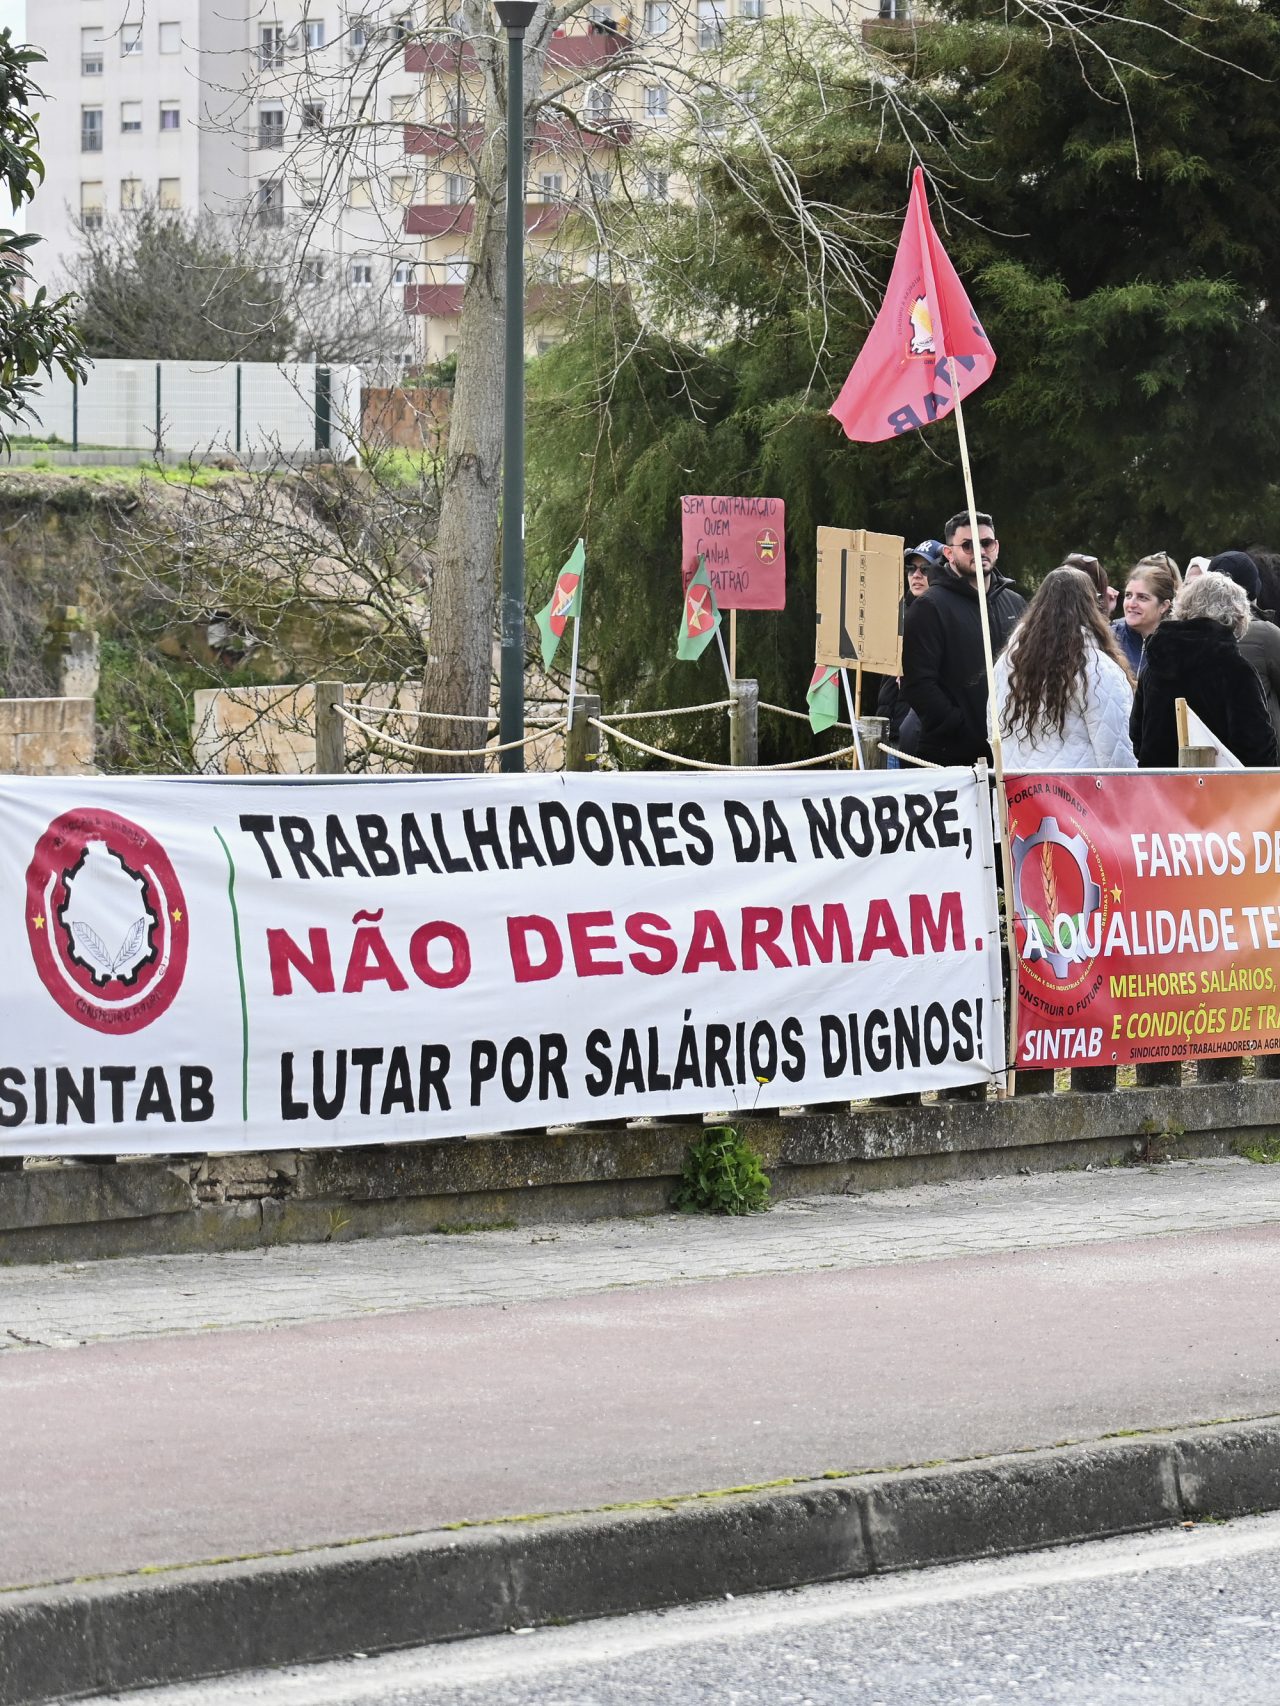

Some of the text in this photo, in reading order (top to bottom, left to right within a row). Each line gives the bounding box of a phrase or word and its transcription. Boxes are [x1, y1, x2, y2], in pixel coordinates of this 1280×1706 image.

[683, 496, 705, 514] SEM
[703, 516, 730, 536] QUEM
[710, 566, 750, 592] PATRÃO
[1008, 783, 1088, 817] FORÇAR A UNIDADE
[239, 790, 973, 880] TRABALHADORES DA NOBRE,
[1130, 831, 1246, 878] FARTOS
[266, 891, 983, 996] NÃO DESARMAM.
[1022, 914, 1048, 959] A
[1054, 907, 1239, 964] QUALIDADE
[1019, 975, 1103, 1016] ONSTRUIR O FUTURO
[1109, 971, 1196, 999] MELHORES
[1200, 963, 1277, 995] SALÁRIOS,
[1111, 1014, 1122, 1040] E
[1126, 1002, 1226, 1041] CONDIÇÕES
[1230, 1007, 1251, 1032] DE
[281, 998, 983, 1121] LUTAR POR SALÁRIOS DIGNOS!
[1022, 1027, 1104, 1061] SINTAB
[1129, 1046, 1171, 1058] SINDICATO
[1171, 1045, 1187, 1056] DOS
[1189, 1041, 1250, 1055] TRABALHADORES
[0, 1065, 214, 1127] SINTAB
